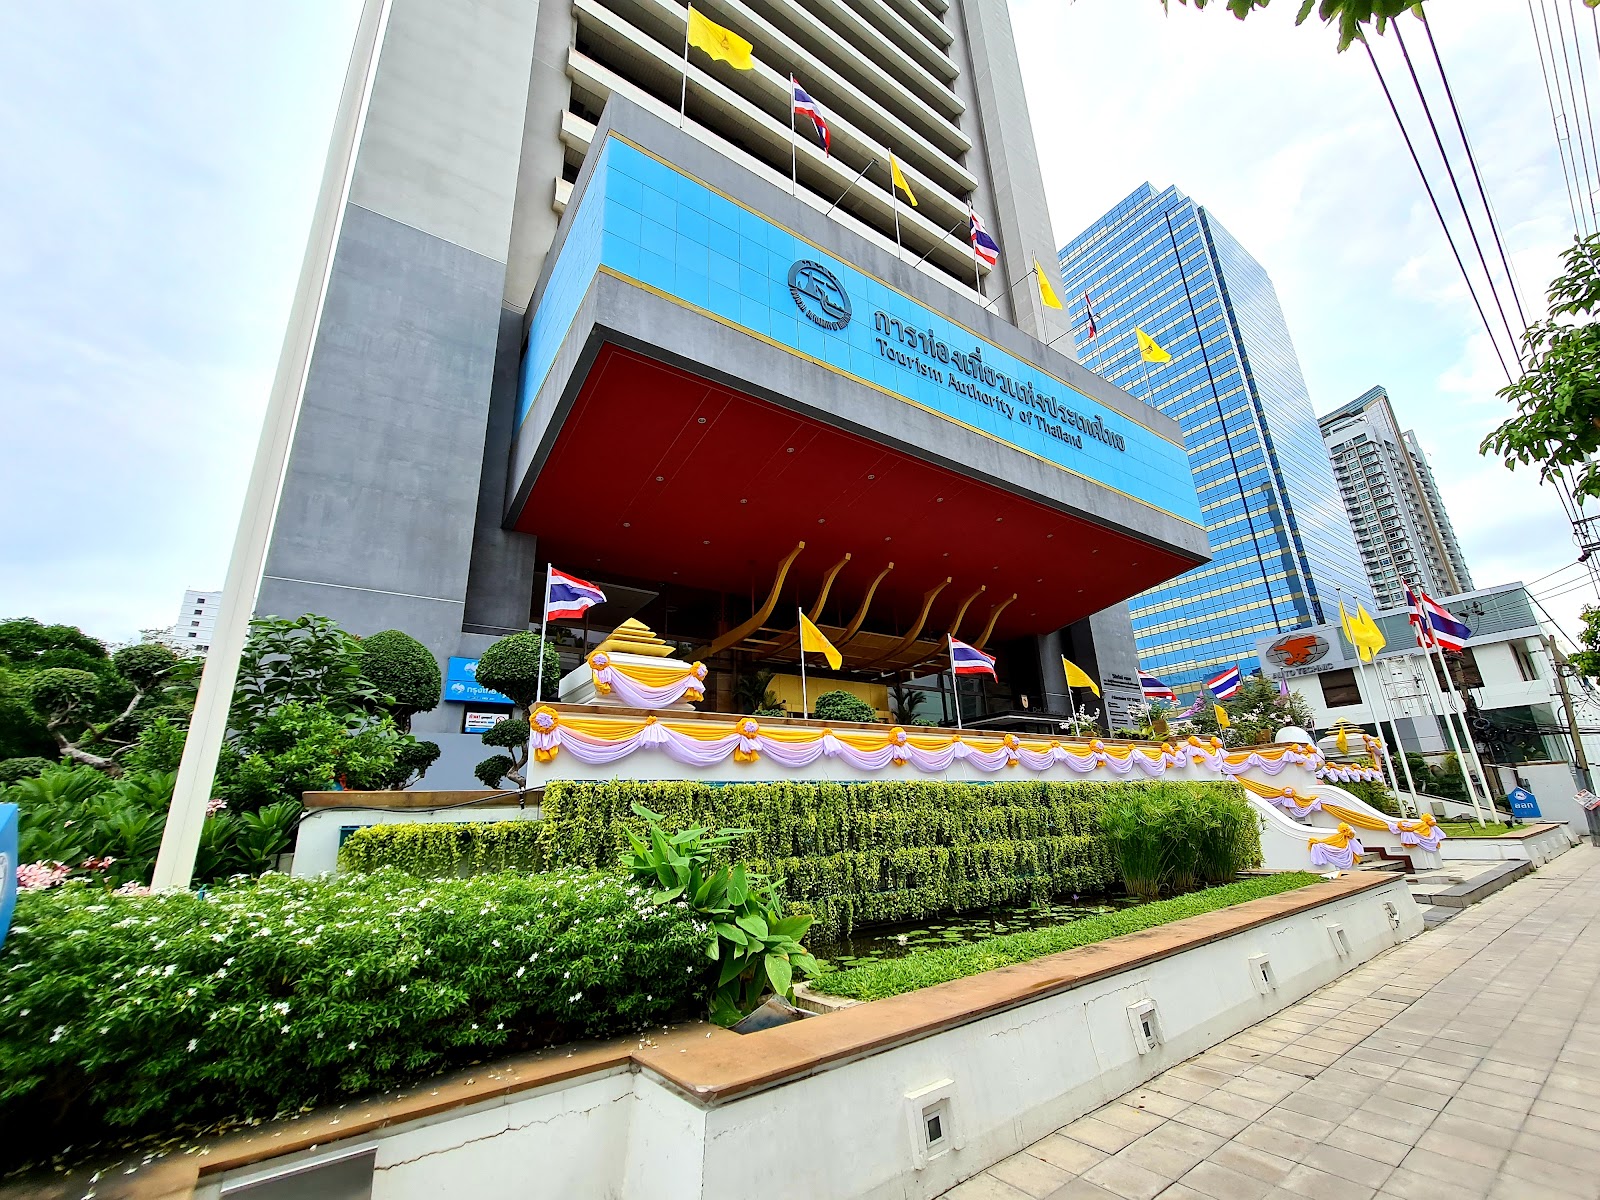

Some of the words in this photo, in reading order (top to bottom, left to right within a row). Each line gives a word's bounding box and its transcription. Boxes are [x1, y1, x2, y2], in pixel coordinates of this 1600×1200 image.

[874, 310, 1126, 452] การท่องเที่ยวแห่งประเทศไทย
[876, 337, 943, 384] Tourism
[948, 372, 1015, 420] Authority
[1019, 410, 1033, 426] of
[1034, 413, 1083, 450] Thailand
